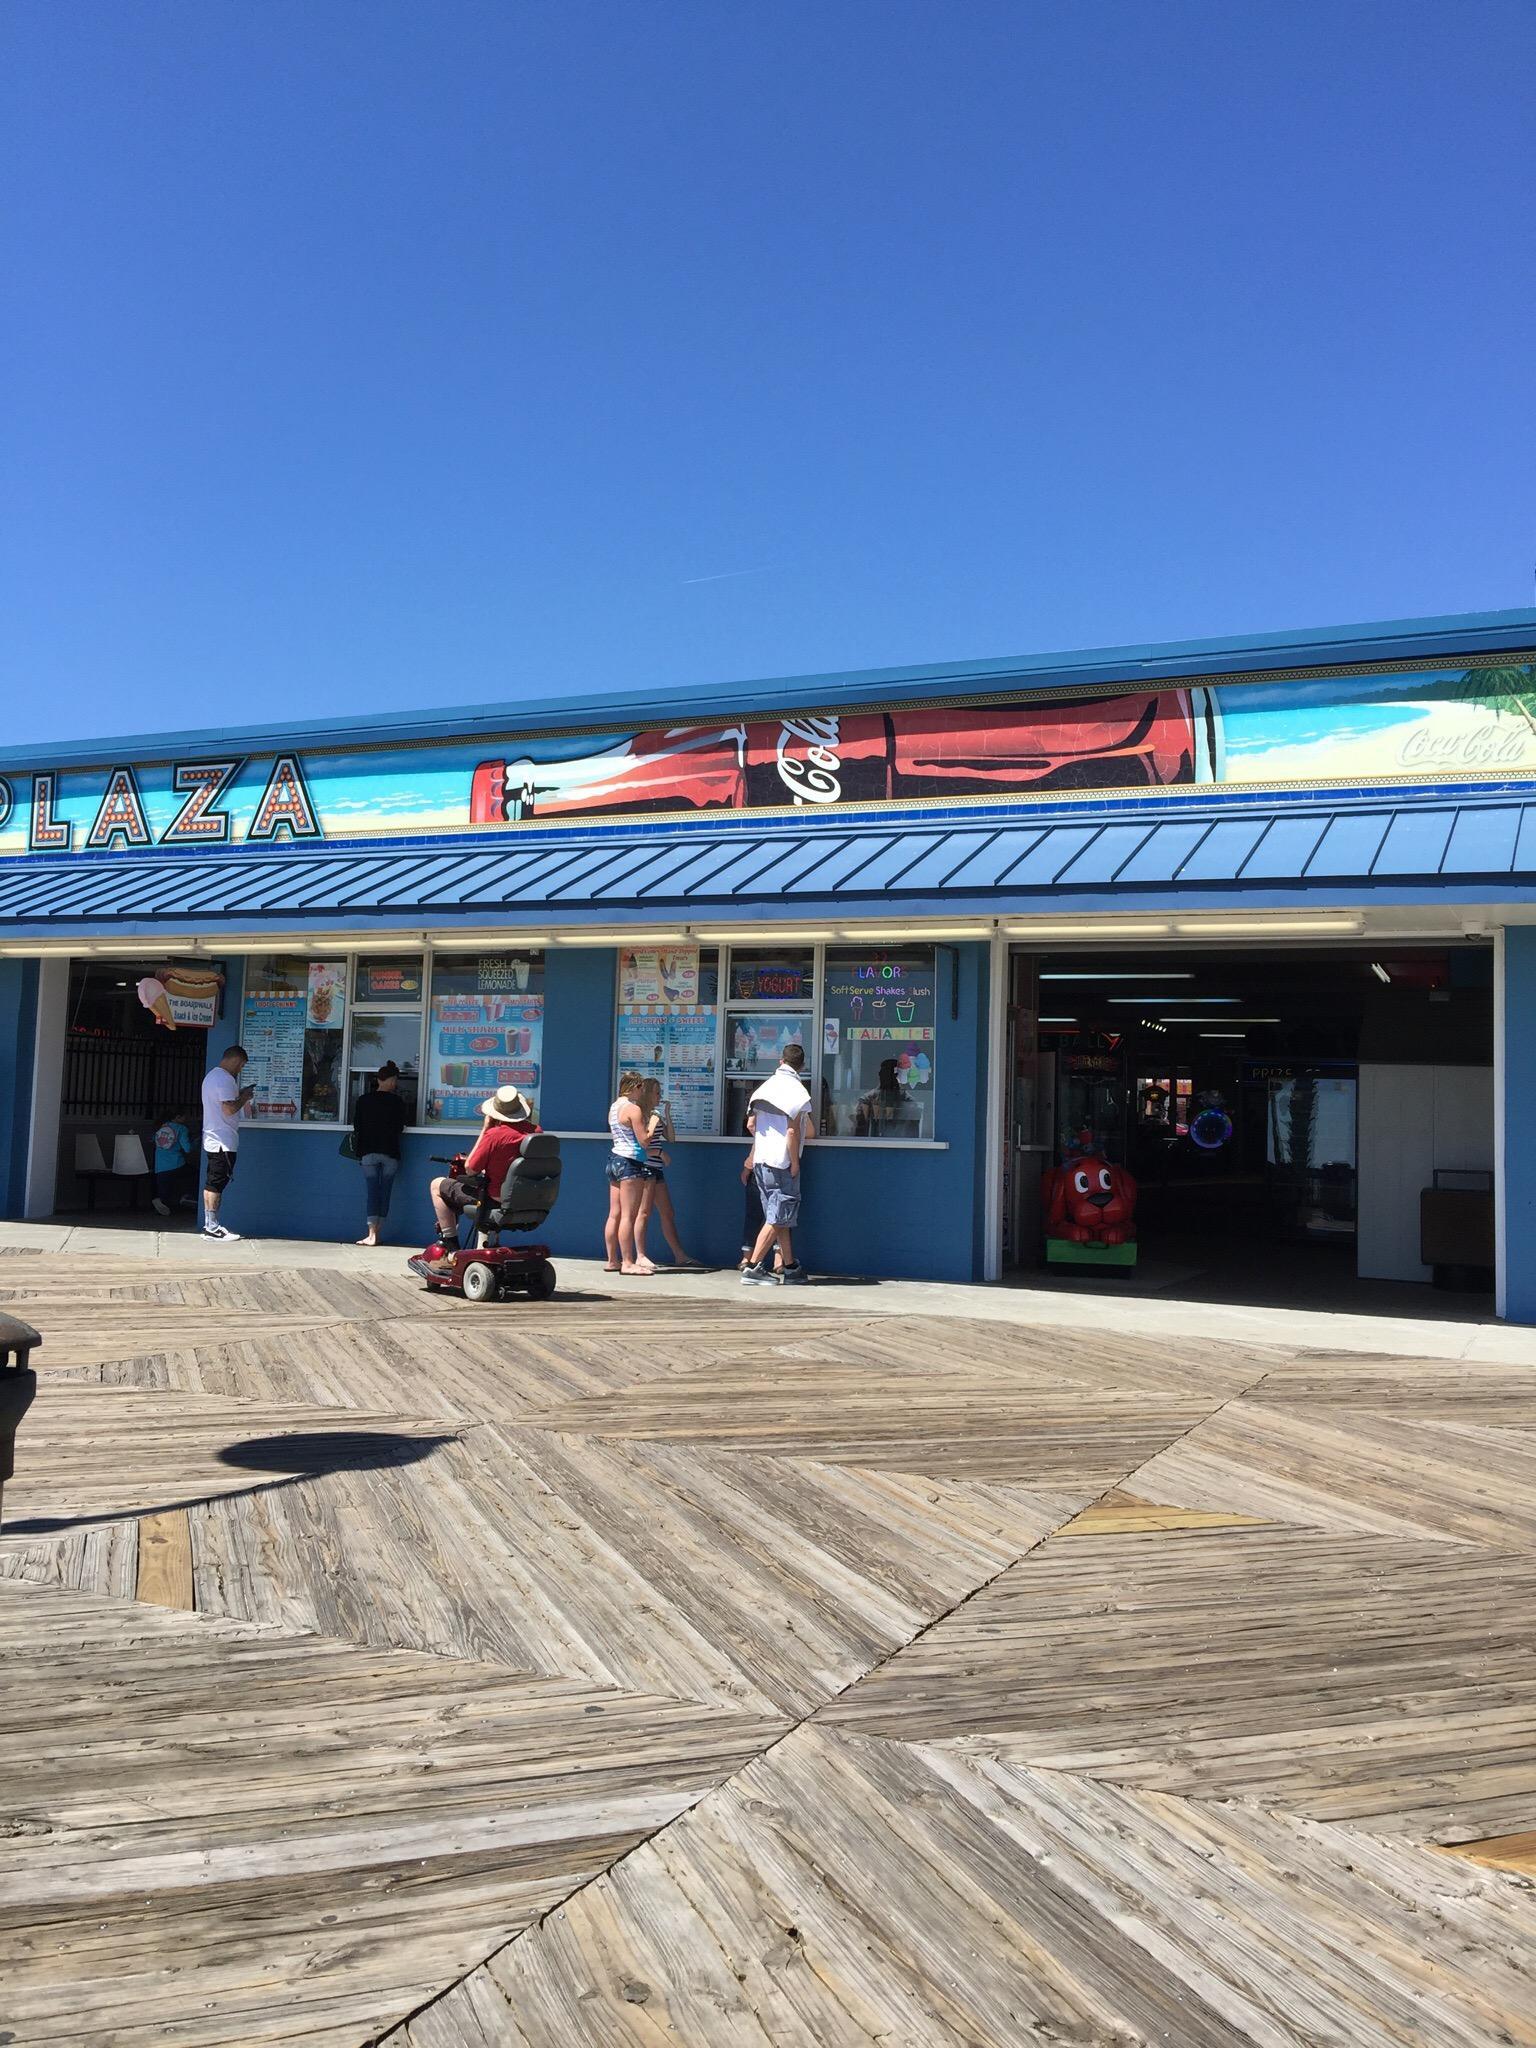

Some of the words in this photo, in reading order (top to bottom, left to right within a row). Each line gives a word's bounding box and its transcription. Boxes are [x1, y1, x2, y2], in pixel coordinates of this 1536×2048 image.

[0, 751, 325, 854] LAZA
[478, 959, 507, 969] FRESH
[478, 969, 514, 980] SQUEEZED
[477, 980, 516, 990] LEMONADE
[758, 975, 801, 994] YOGURT
[831, 985, 849, 995] Soft
[849, 985, 874, 995] Serve
[875, 986, 906, 996] Shakes
